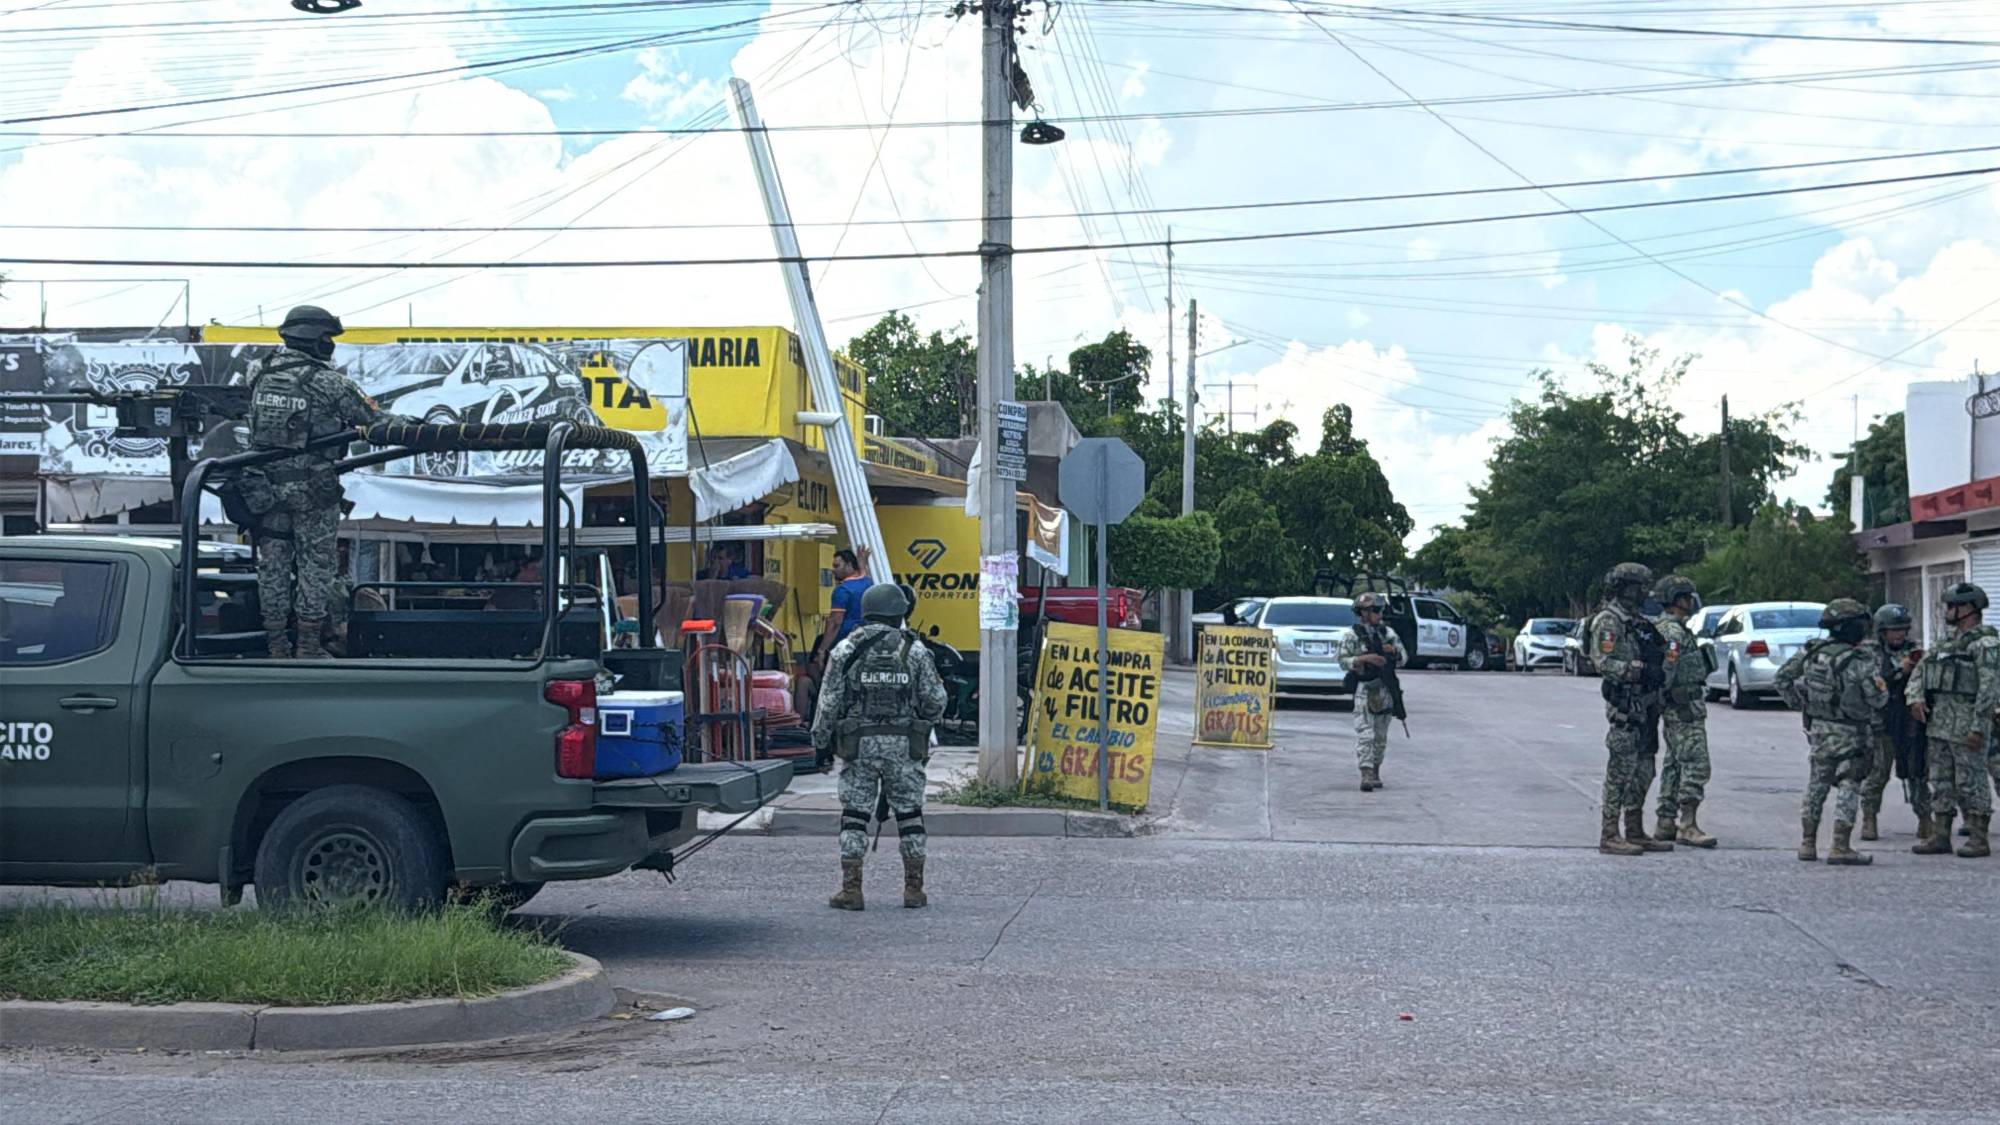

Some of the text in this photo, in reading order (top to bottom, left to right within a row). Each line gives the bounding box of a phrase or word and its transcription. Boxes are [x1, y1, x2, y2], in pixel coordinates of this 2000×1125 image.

[688, 337, 760, 367] NARIA
[494, 448, 600, 469] QUAER
[797, 478, 829, 513] ELOTA
[1205, 634, 1269, 648] EN LA COMPRA
[1051, 644, 1069, 660] EN
[1073, 646, 1090, 663] LA
[1204, 648, 1268, 667] de ACEITE
[1047, 665, 1156, 700] de ACEITE
[1215, 668, 1266, 686] FILTRO
[1065, 694, 1149, 725] FILTRO
[1052, 723, 1070, 740] EL
[1204, 709, 1265, 735] GRATIS
[1060, 745, 1145, 783] GRATIS
